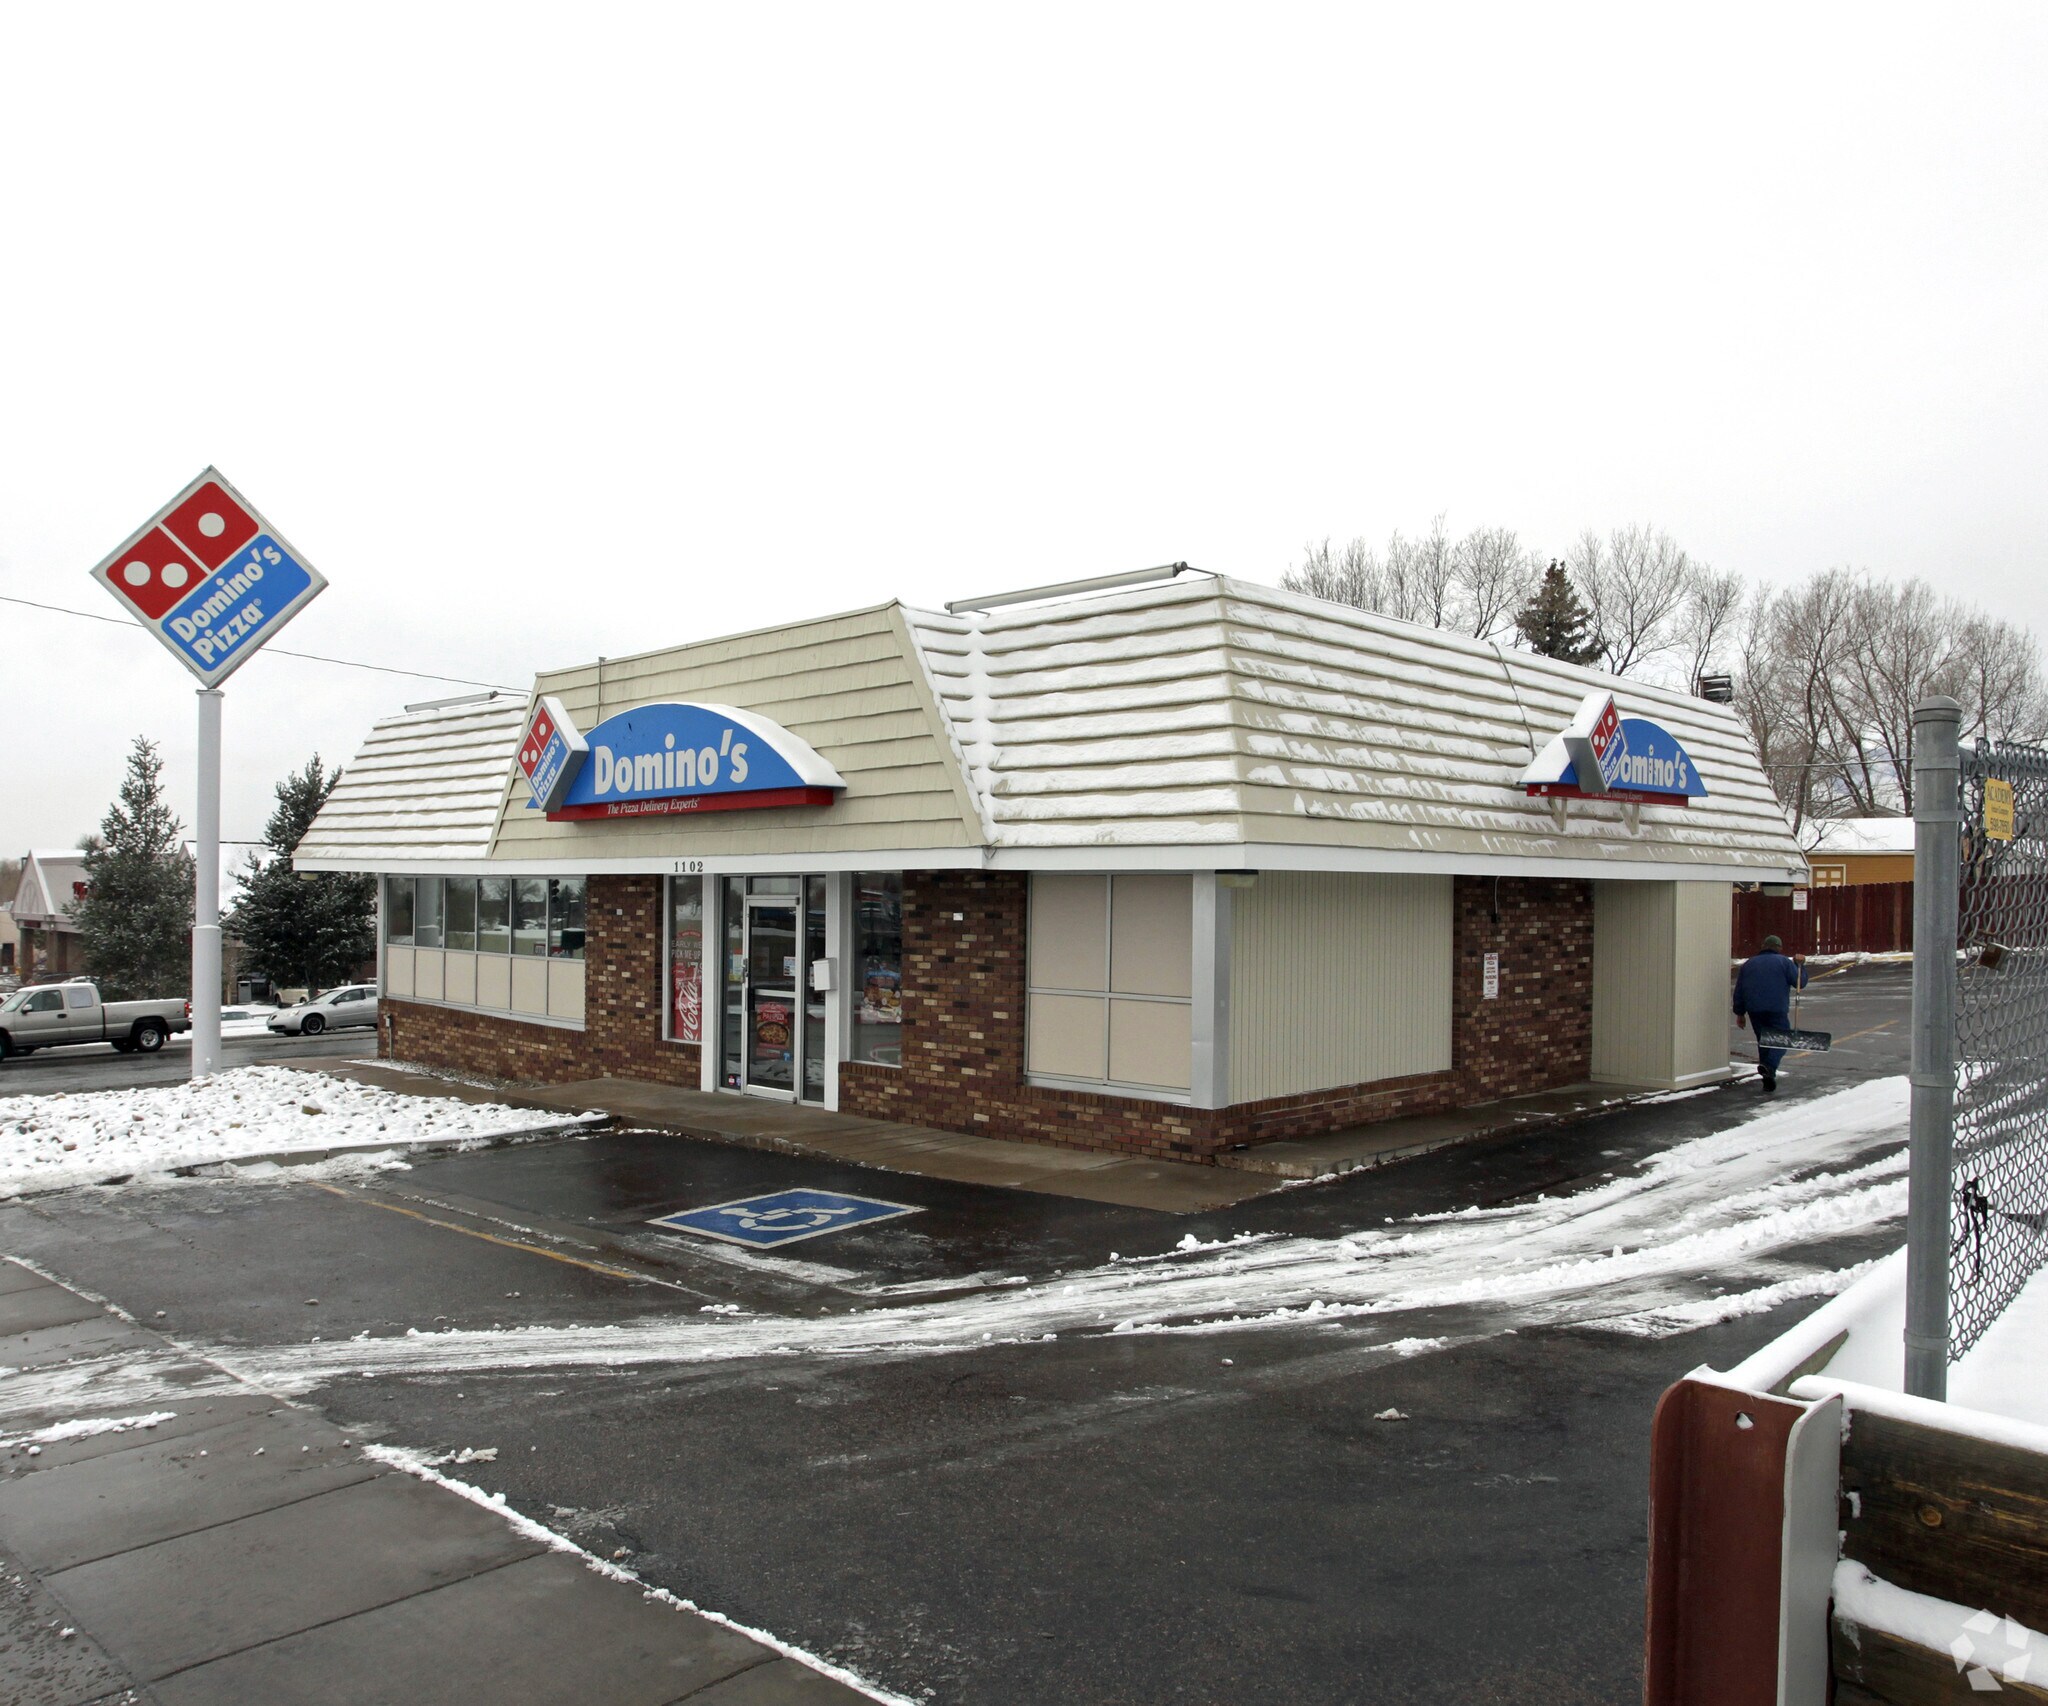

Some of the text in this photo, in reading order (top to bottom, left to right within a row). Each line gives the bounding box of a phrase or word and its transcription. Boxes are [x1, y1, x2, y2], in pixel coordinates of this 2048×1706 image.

[169, 546, 282, 643] Domino's
[191, 602, 264, 664] Pizza
[532, 737, 560, 788] Domino's
[538, 766, 556, 799] Pizza
[594, 729, 749, 795] Domino's
[1611, 744, 1687, 789] omino's
[607, 798, 698, 814] The Pizza Delivery Experts
[674, 861, 704, 872] 1102
